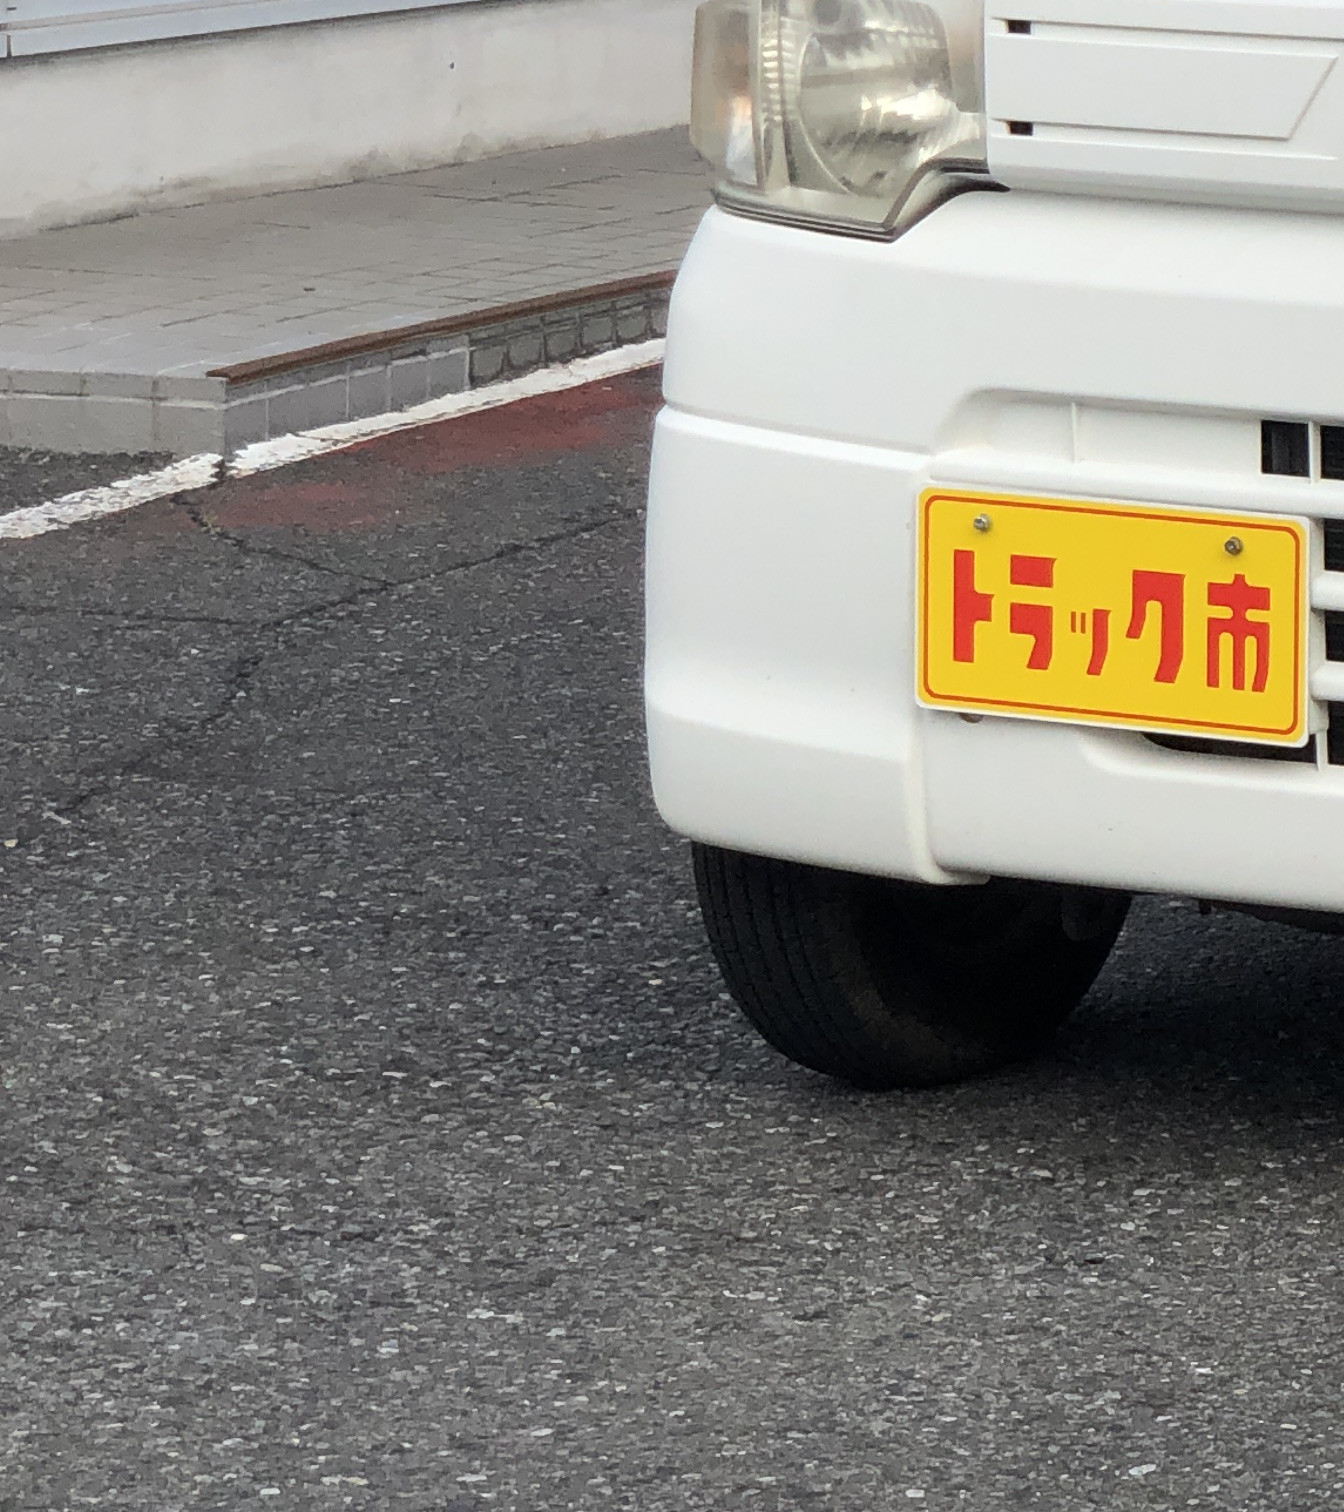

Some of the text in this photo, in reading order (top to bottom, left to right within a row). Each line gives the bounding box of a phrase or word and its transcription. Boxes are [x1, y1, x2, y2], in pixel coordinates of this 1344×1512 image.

[952, 549, 1271, 693] トラック市
